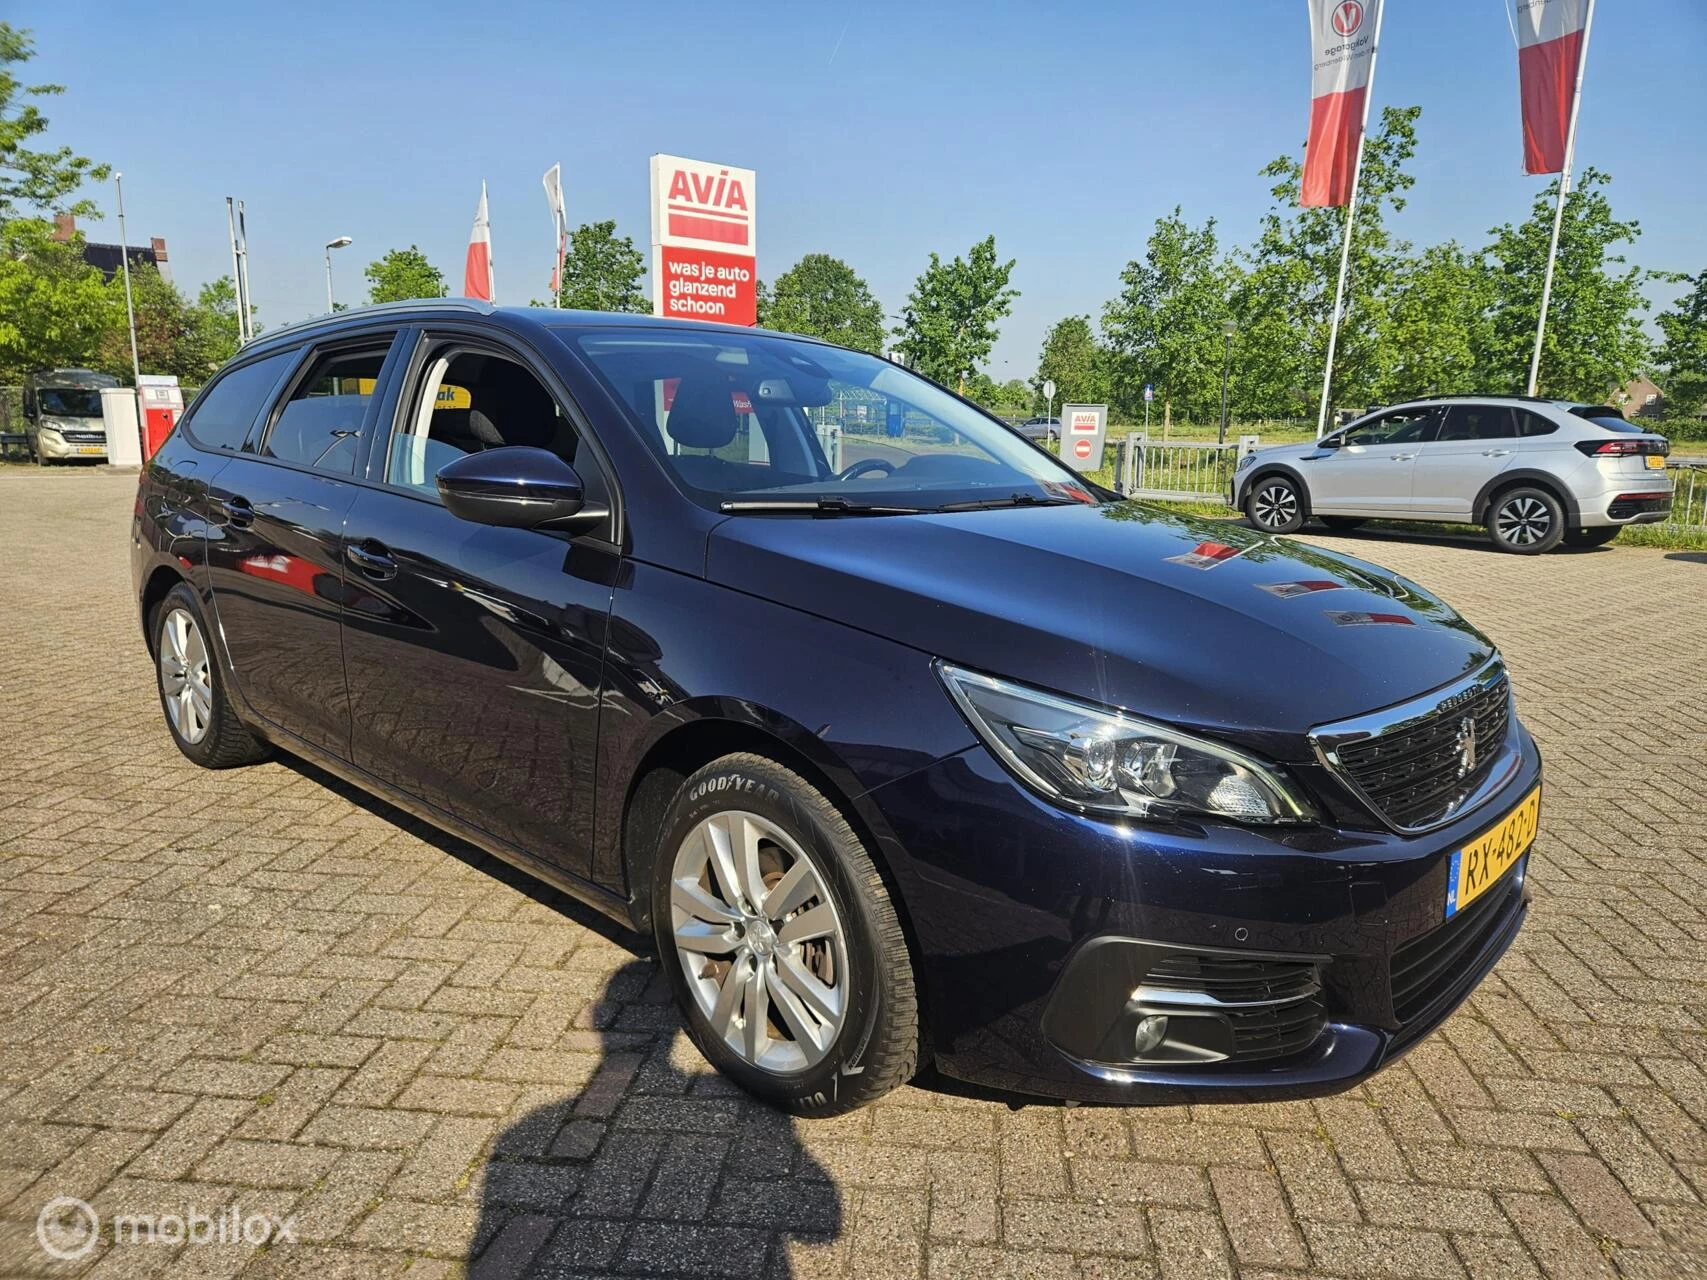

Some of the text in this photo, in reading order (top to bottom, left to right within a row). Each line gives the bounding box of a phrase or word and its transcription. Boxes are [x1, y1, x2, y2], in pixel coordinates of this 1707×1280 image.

[668, 261, 750, 281] was je auto
[669, 279, 736, 298] glanzend
[669, 297, 725, 315] schoon
[1465, 800, 1535, 895] RX-482-D
